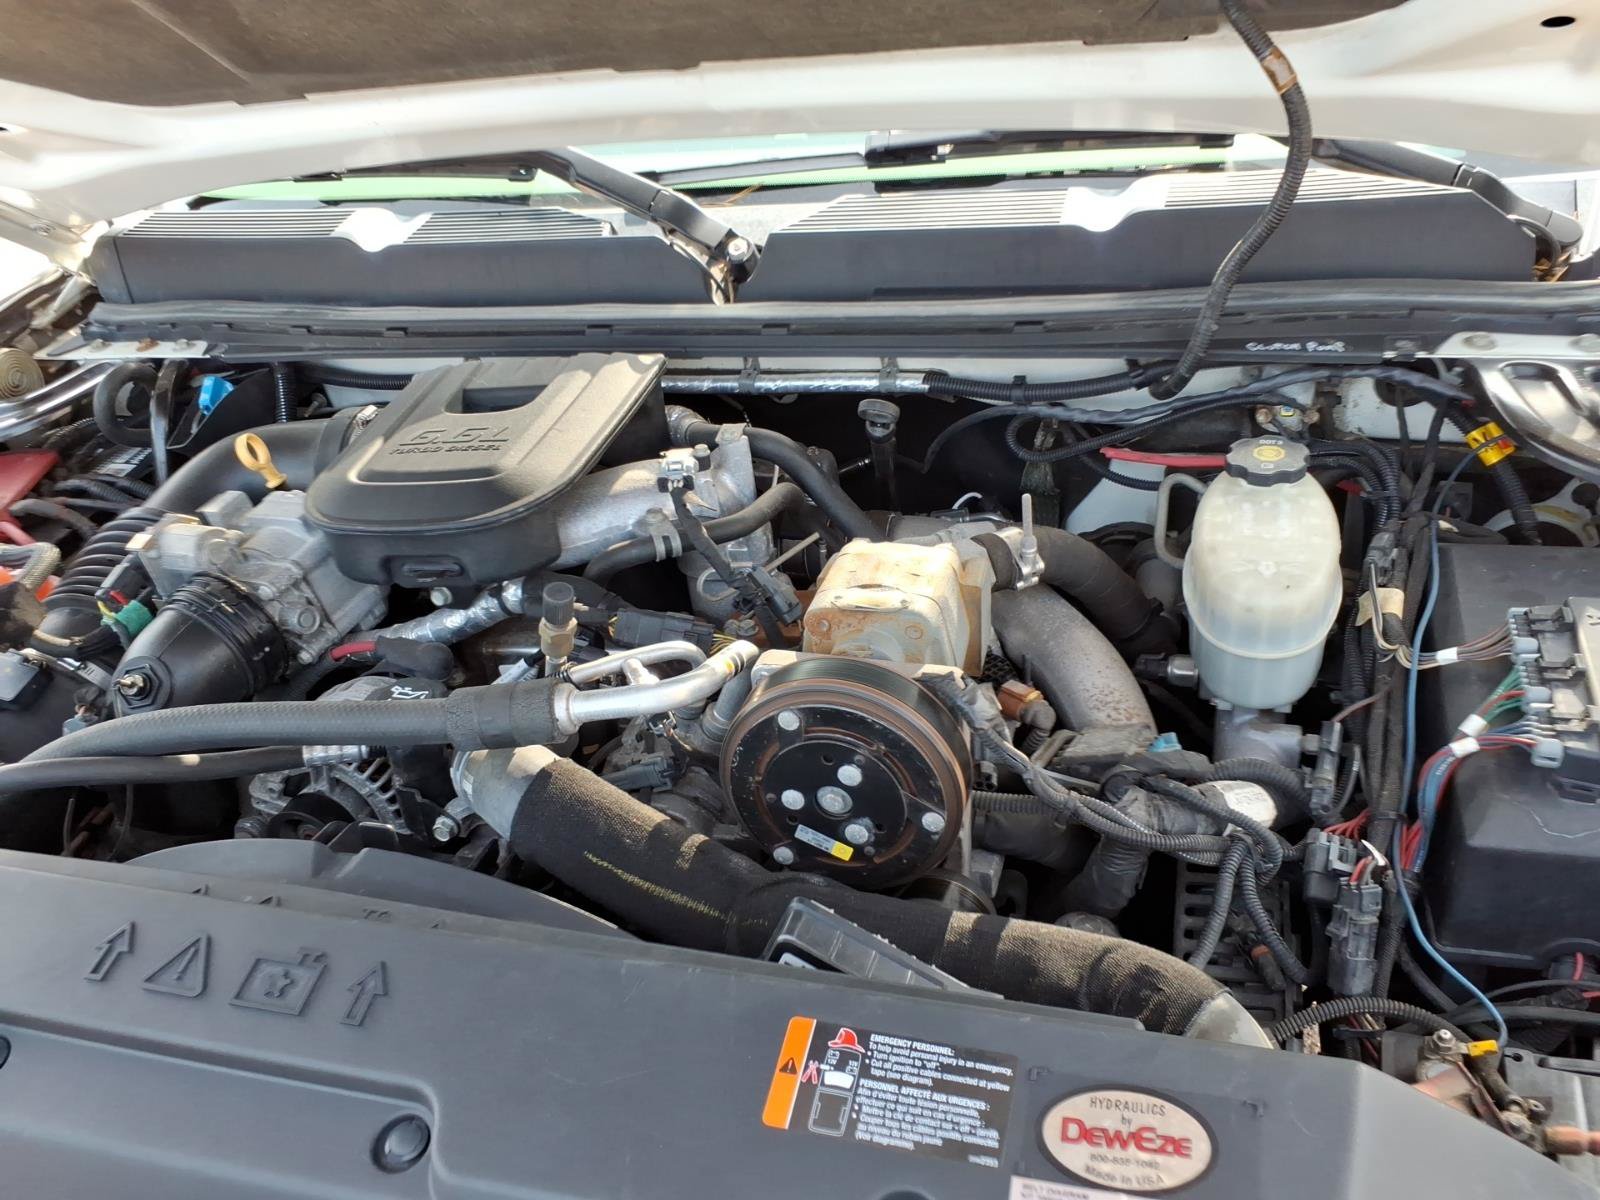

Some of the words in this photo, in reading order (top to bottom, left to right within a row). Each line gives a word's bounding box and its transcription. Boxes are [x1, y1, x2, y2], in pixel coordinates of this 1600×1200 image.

[388, 445, 444, 455] TURBO
[445, 444, 502, 453] DIESEL
[870, 1033, 912, 1048] EMERGENCY
[912, 1041, 955, 1056] PERSONNEL:
[869, 1041, 877, 1050] To
[877, 1044, 891, 1054] help
[892, 1046, 910, 1056] avoid
[910, 1050, 938, 1062] personal
[939, 1054, 957, 1066] injury
[958, 1058, 965, 1066] in
[965, 1060, 975, 1068] an
[975, 1062, 1014, 1077] emergency.
[872, 1050, 888, 1060] Turn
[889, 1052, 914, 1066] ignition
[914, 1058, 922, 1066] to
[870, 1067, 886, 1078] tape
[870, 1058, 883, 1068] Cut
[892, 1063, 919, 1075] positive
[920, 1068, 942, 1079] cables
[942, 1072, 978, 1086] connected
[978, 1079, 987, 1088] at
[986, 1081, 1011, 1093] yellow
[859, 1078, 900, 1094] PERSONNEL
[932, 1092, 948, 1103] AUX
[948, 1095, 986, 1110] URGENCES
[898, 1094, 917, 1105] toute
[886, 1102, 896, 1110] ce
[896, 1104, 908, 1112] qui
[1089, 1096, 1167, 1117] HYDRAULICS
[1121, 1113, 1133, 1128] by
[1085, 1163, 1117, 1182] Made
[1136, 1174, 1165, 1186] USA
